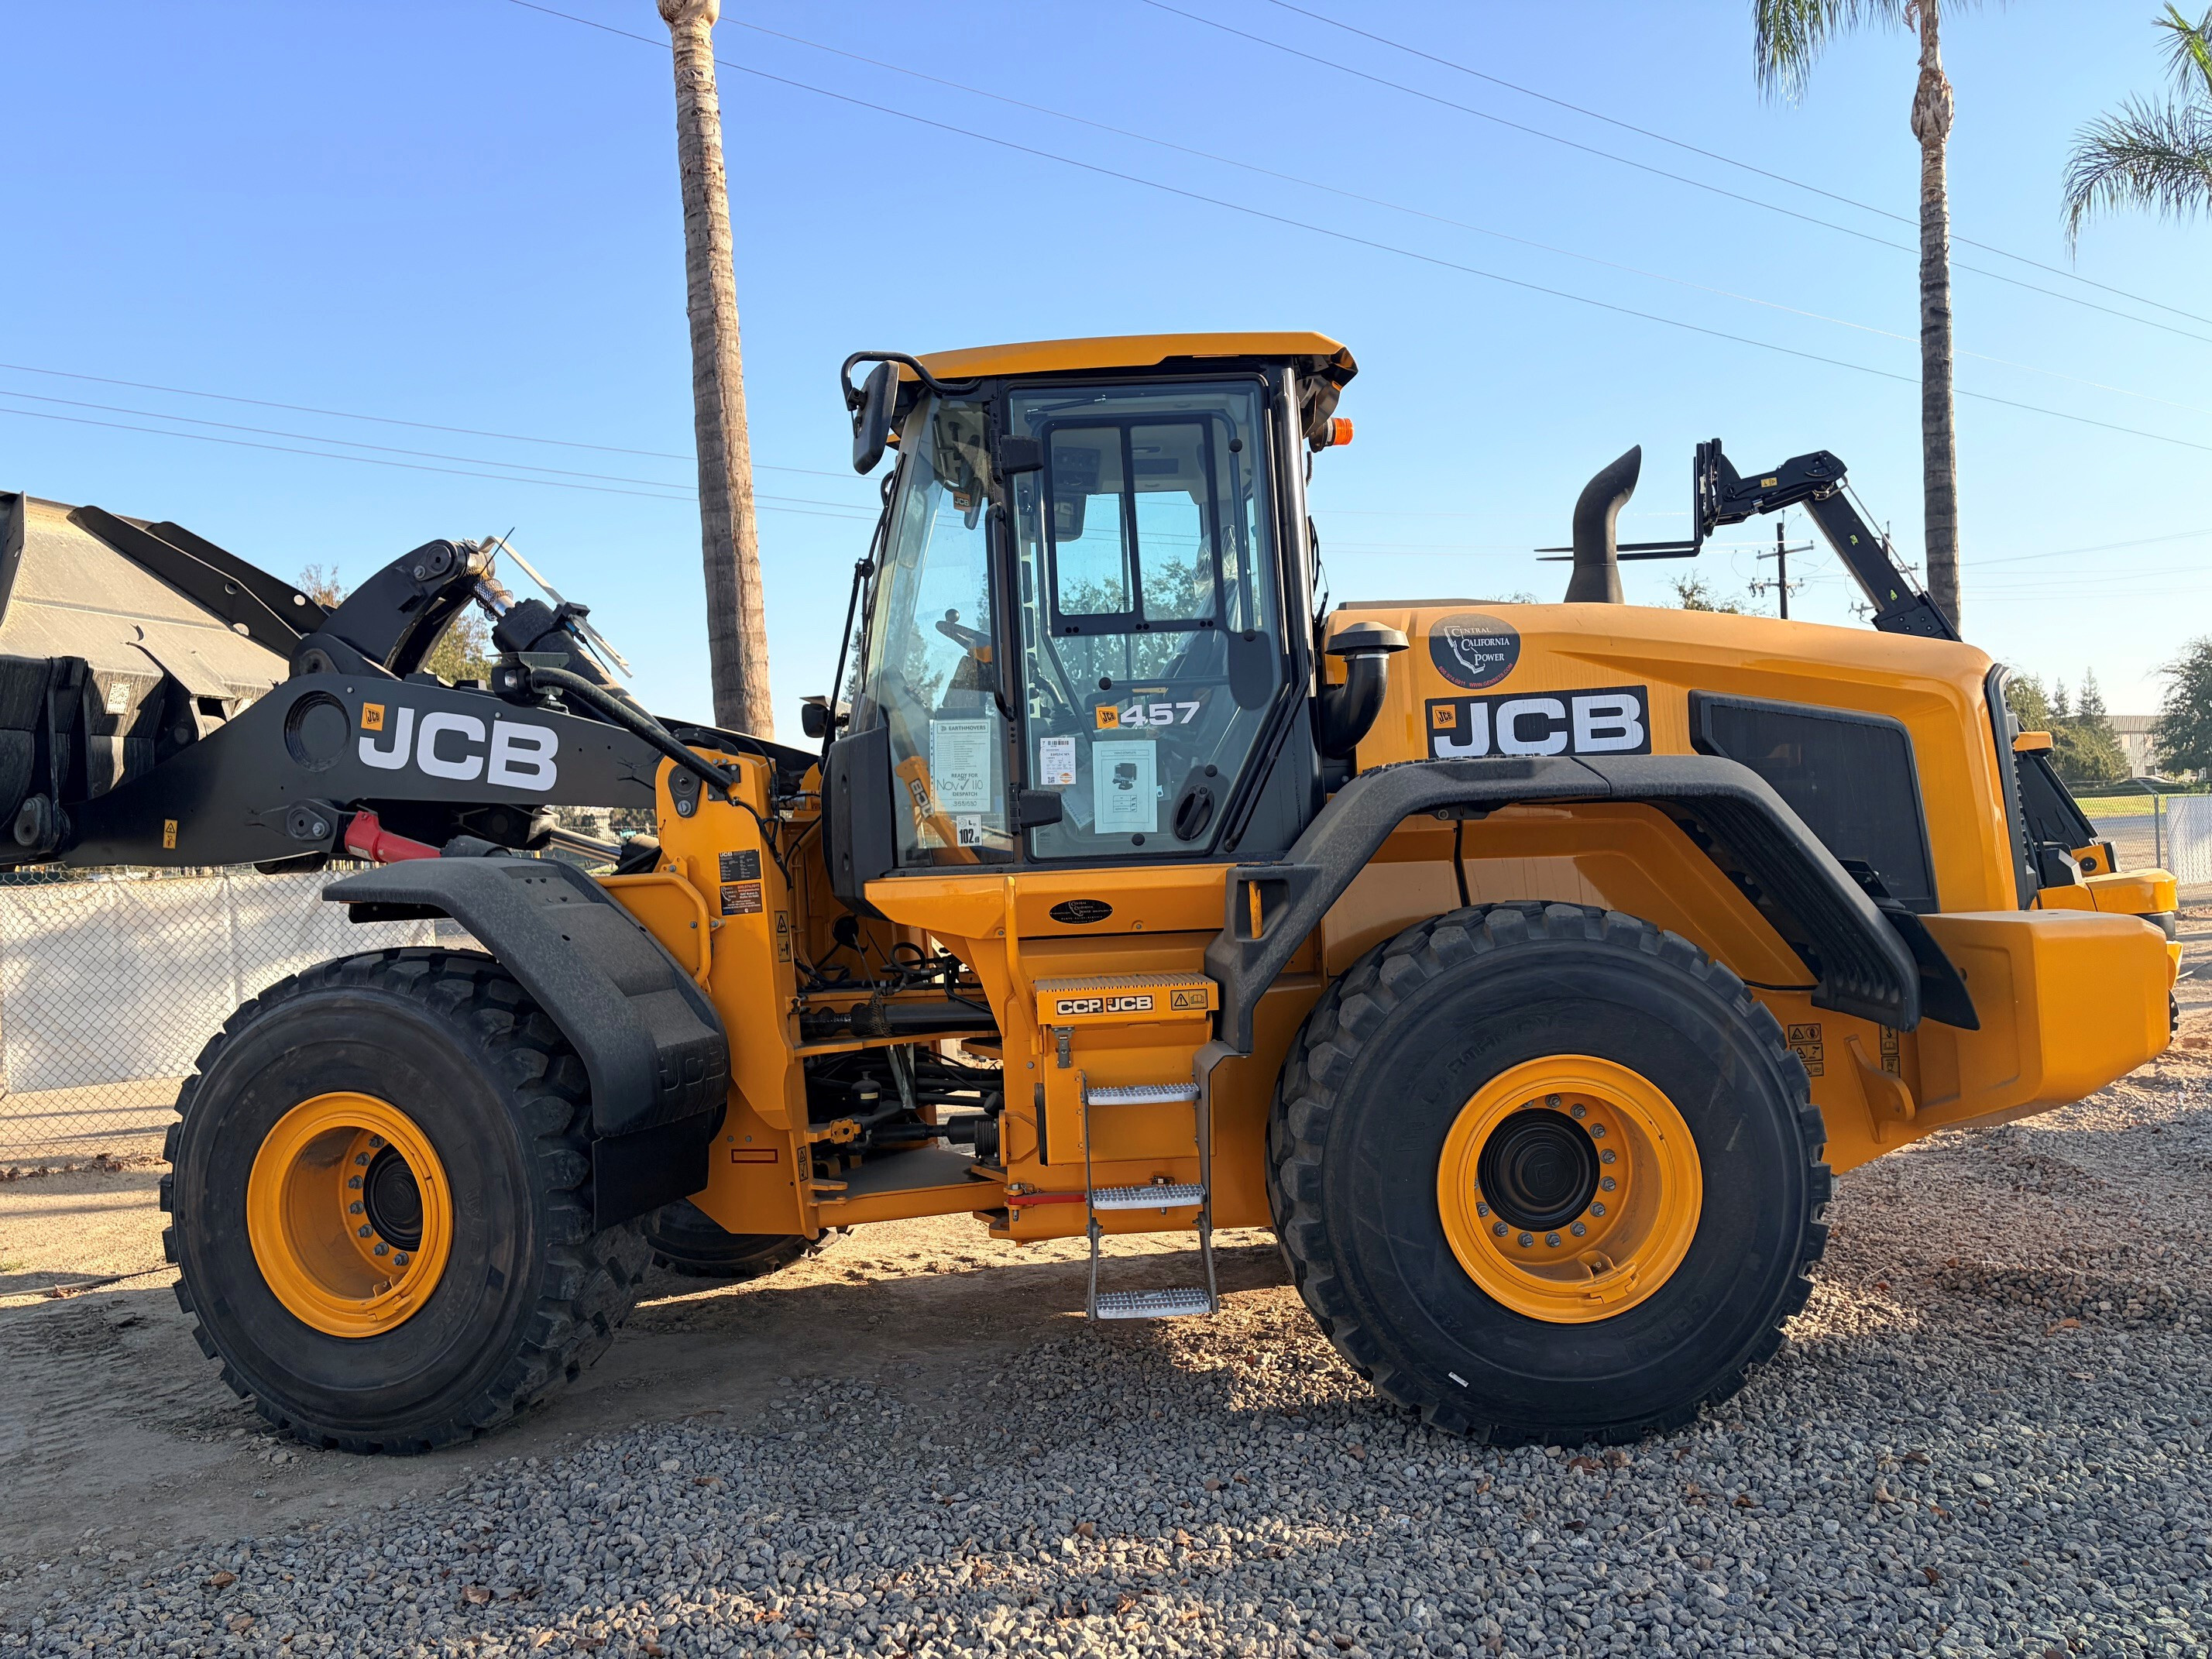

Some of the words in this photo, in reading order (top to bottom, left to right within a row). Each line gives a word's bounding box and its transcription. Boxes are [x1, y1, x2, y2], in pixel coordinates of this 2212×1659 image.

[955, 497, 970, 507] JCB
[1451, 627, 1492, 637] CENTRAL
[1461, 637, 1510, 651] CALIFORNIA
[1474, 653, 1505, 666] POWER
[366, 709, 381, 723] JCB
[1101, 711, 1116, 723] JCB
[1120, 700, 1200, 726] 457
[1437, 709, 1454, 724] JCB
[1434, 694, 1644, 759] JCB
[359, 706, 559, 792] JCB
[959, 828, 974, 844] 102
[1057, 999, 1101, 1014] CCP
[1107, 997, 1152, 1012] JCB
